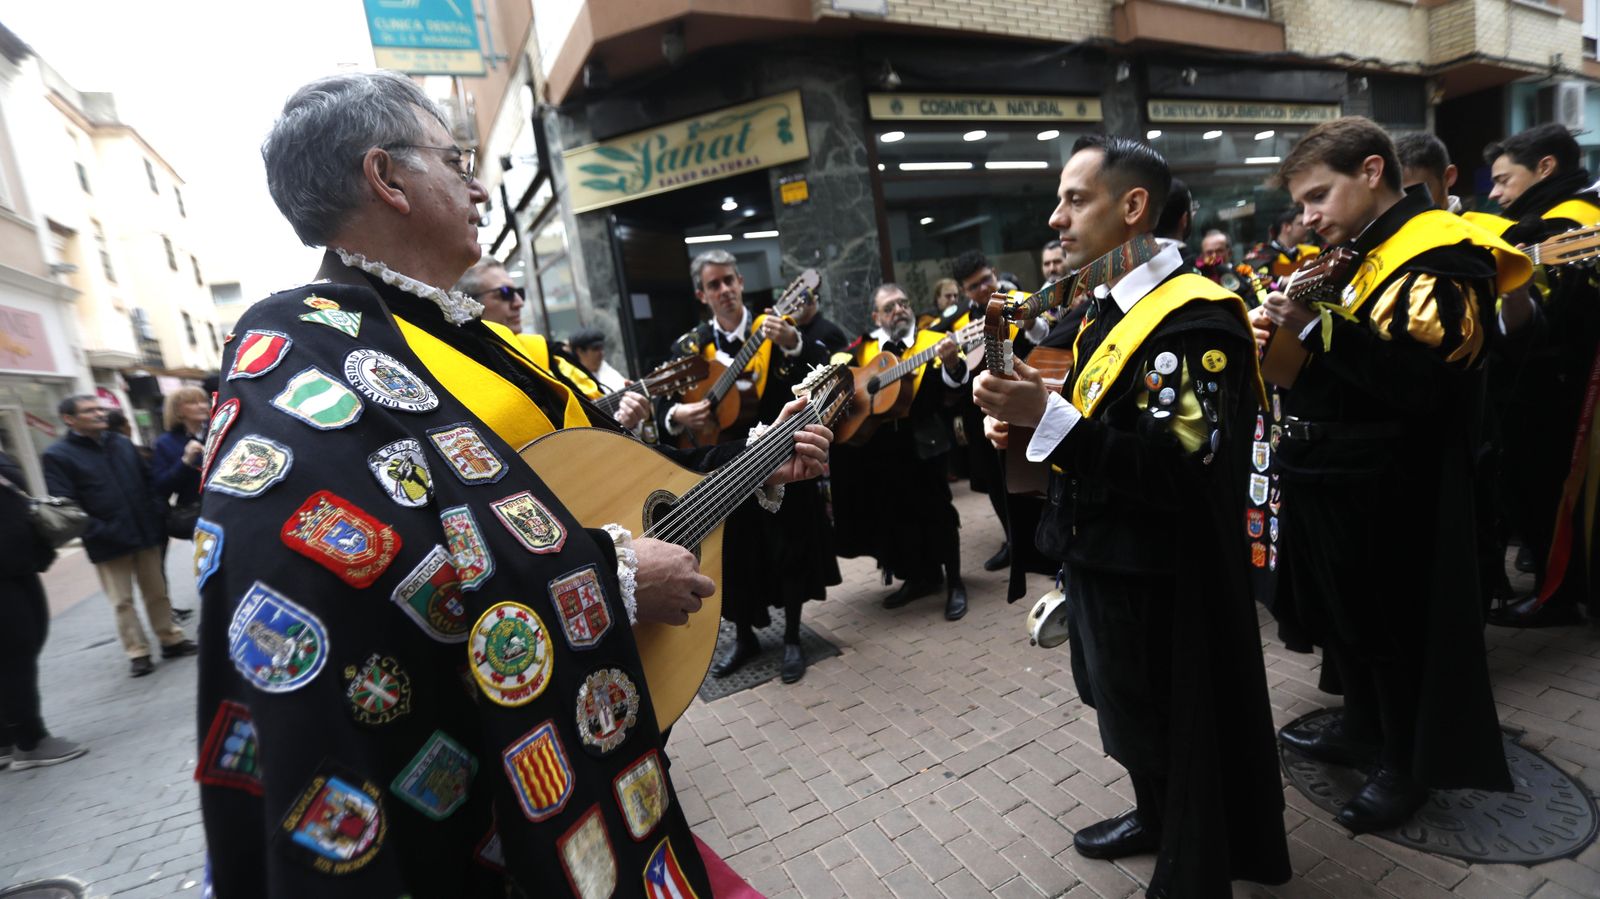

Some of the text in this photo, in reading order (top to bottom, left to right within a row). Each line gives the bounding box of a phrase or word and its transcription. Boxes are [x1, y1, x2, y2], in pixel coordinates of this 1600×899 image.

[374, 17, 472, 34] CLINICA DENTAL
[920, 99, 1063, 116] COSMETICA NATURAL
[658, 156, 761, 188] SALUD NATURAL
[346, 354, 401, 408] UNIVERSIDAD
[400, 554, 447, 600] PORTUGAL
[283, 776, 326, 832] SEVILLA
